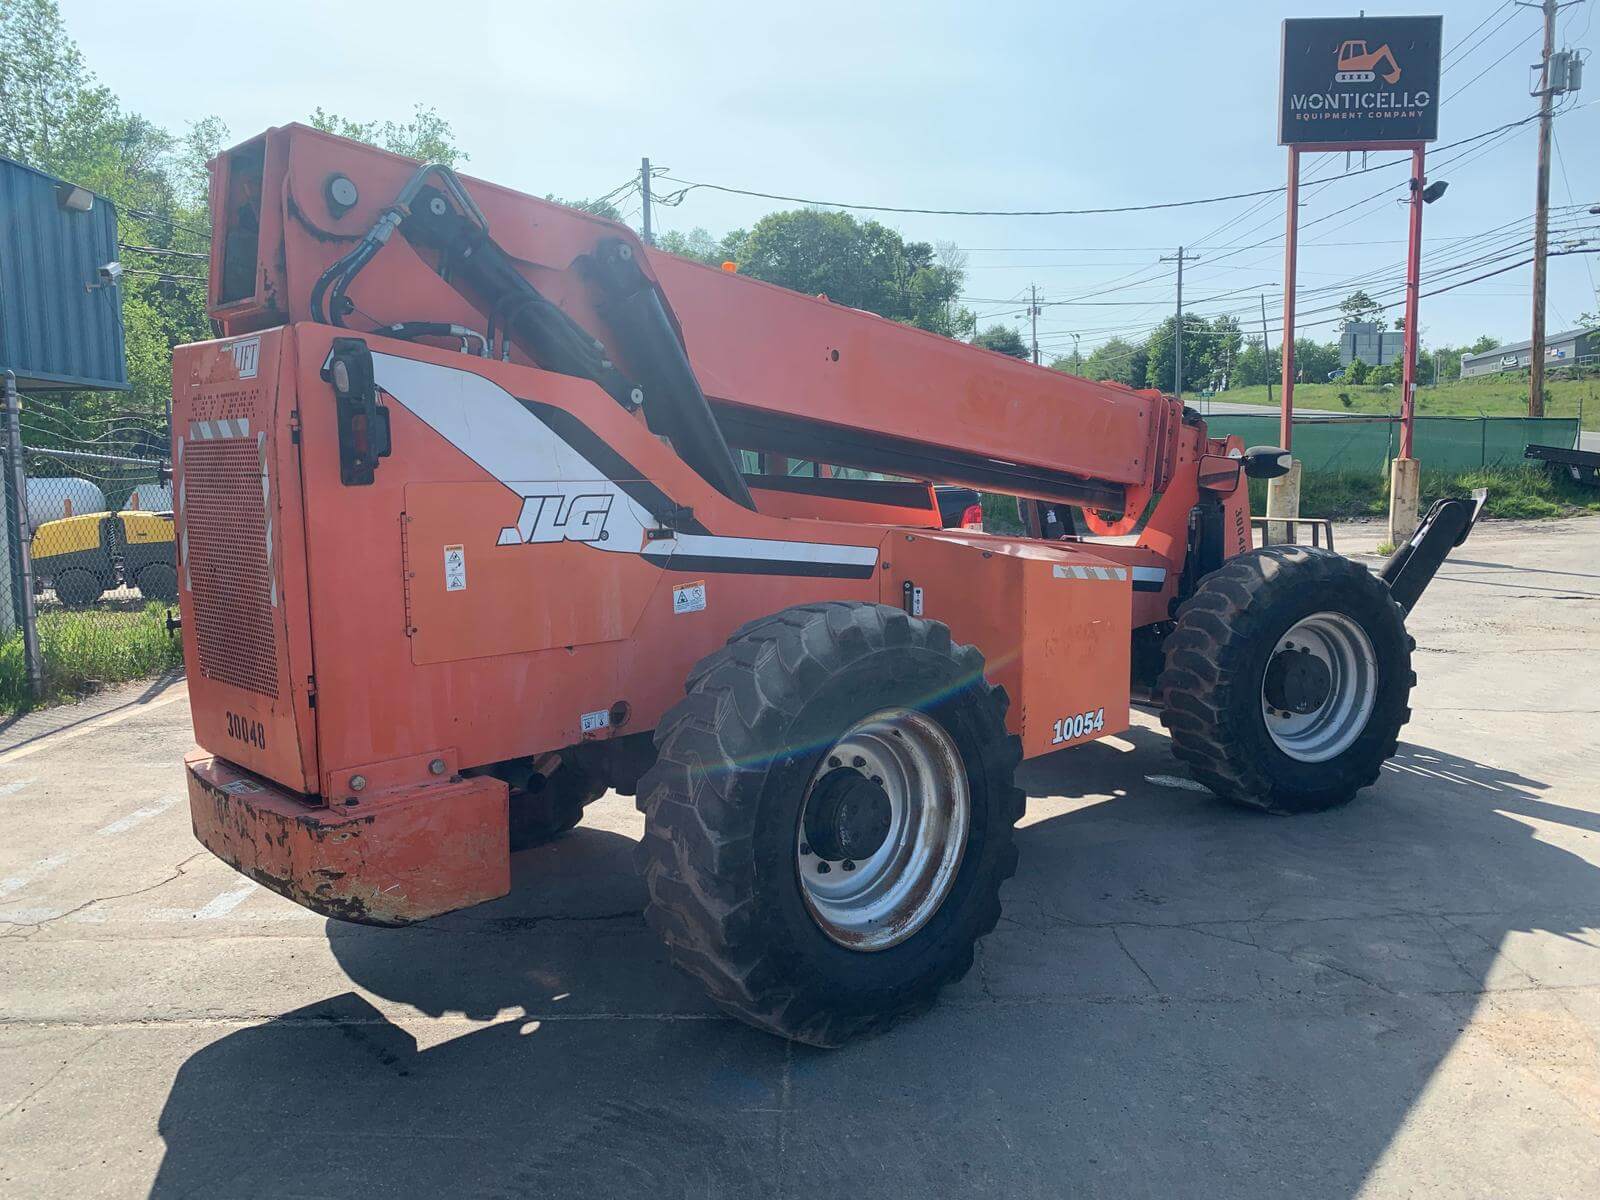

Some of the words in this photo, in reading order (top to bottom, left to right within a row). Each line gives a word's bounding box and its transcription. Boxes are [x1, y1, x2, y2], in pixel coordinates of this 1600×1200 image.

[1290, 91, 1430, 110] MONTICELLO
[1296, 112, 1363, 121] EQUIPMENT
[1368, 110, 1424, 119] COMPANY
[496, 494, 615, 546] JLG
[226, 711, 266, 750] 30048
[1052, 707, 1104, 745] 10054
